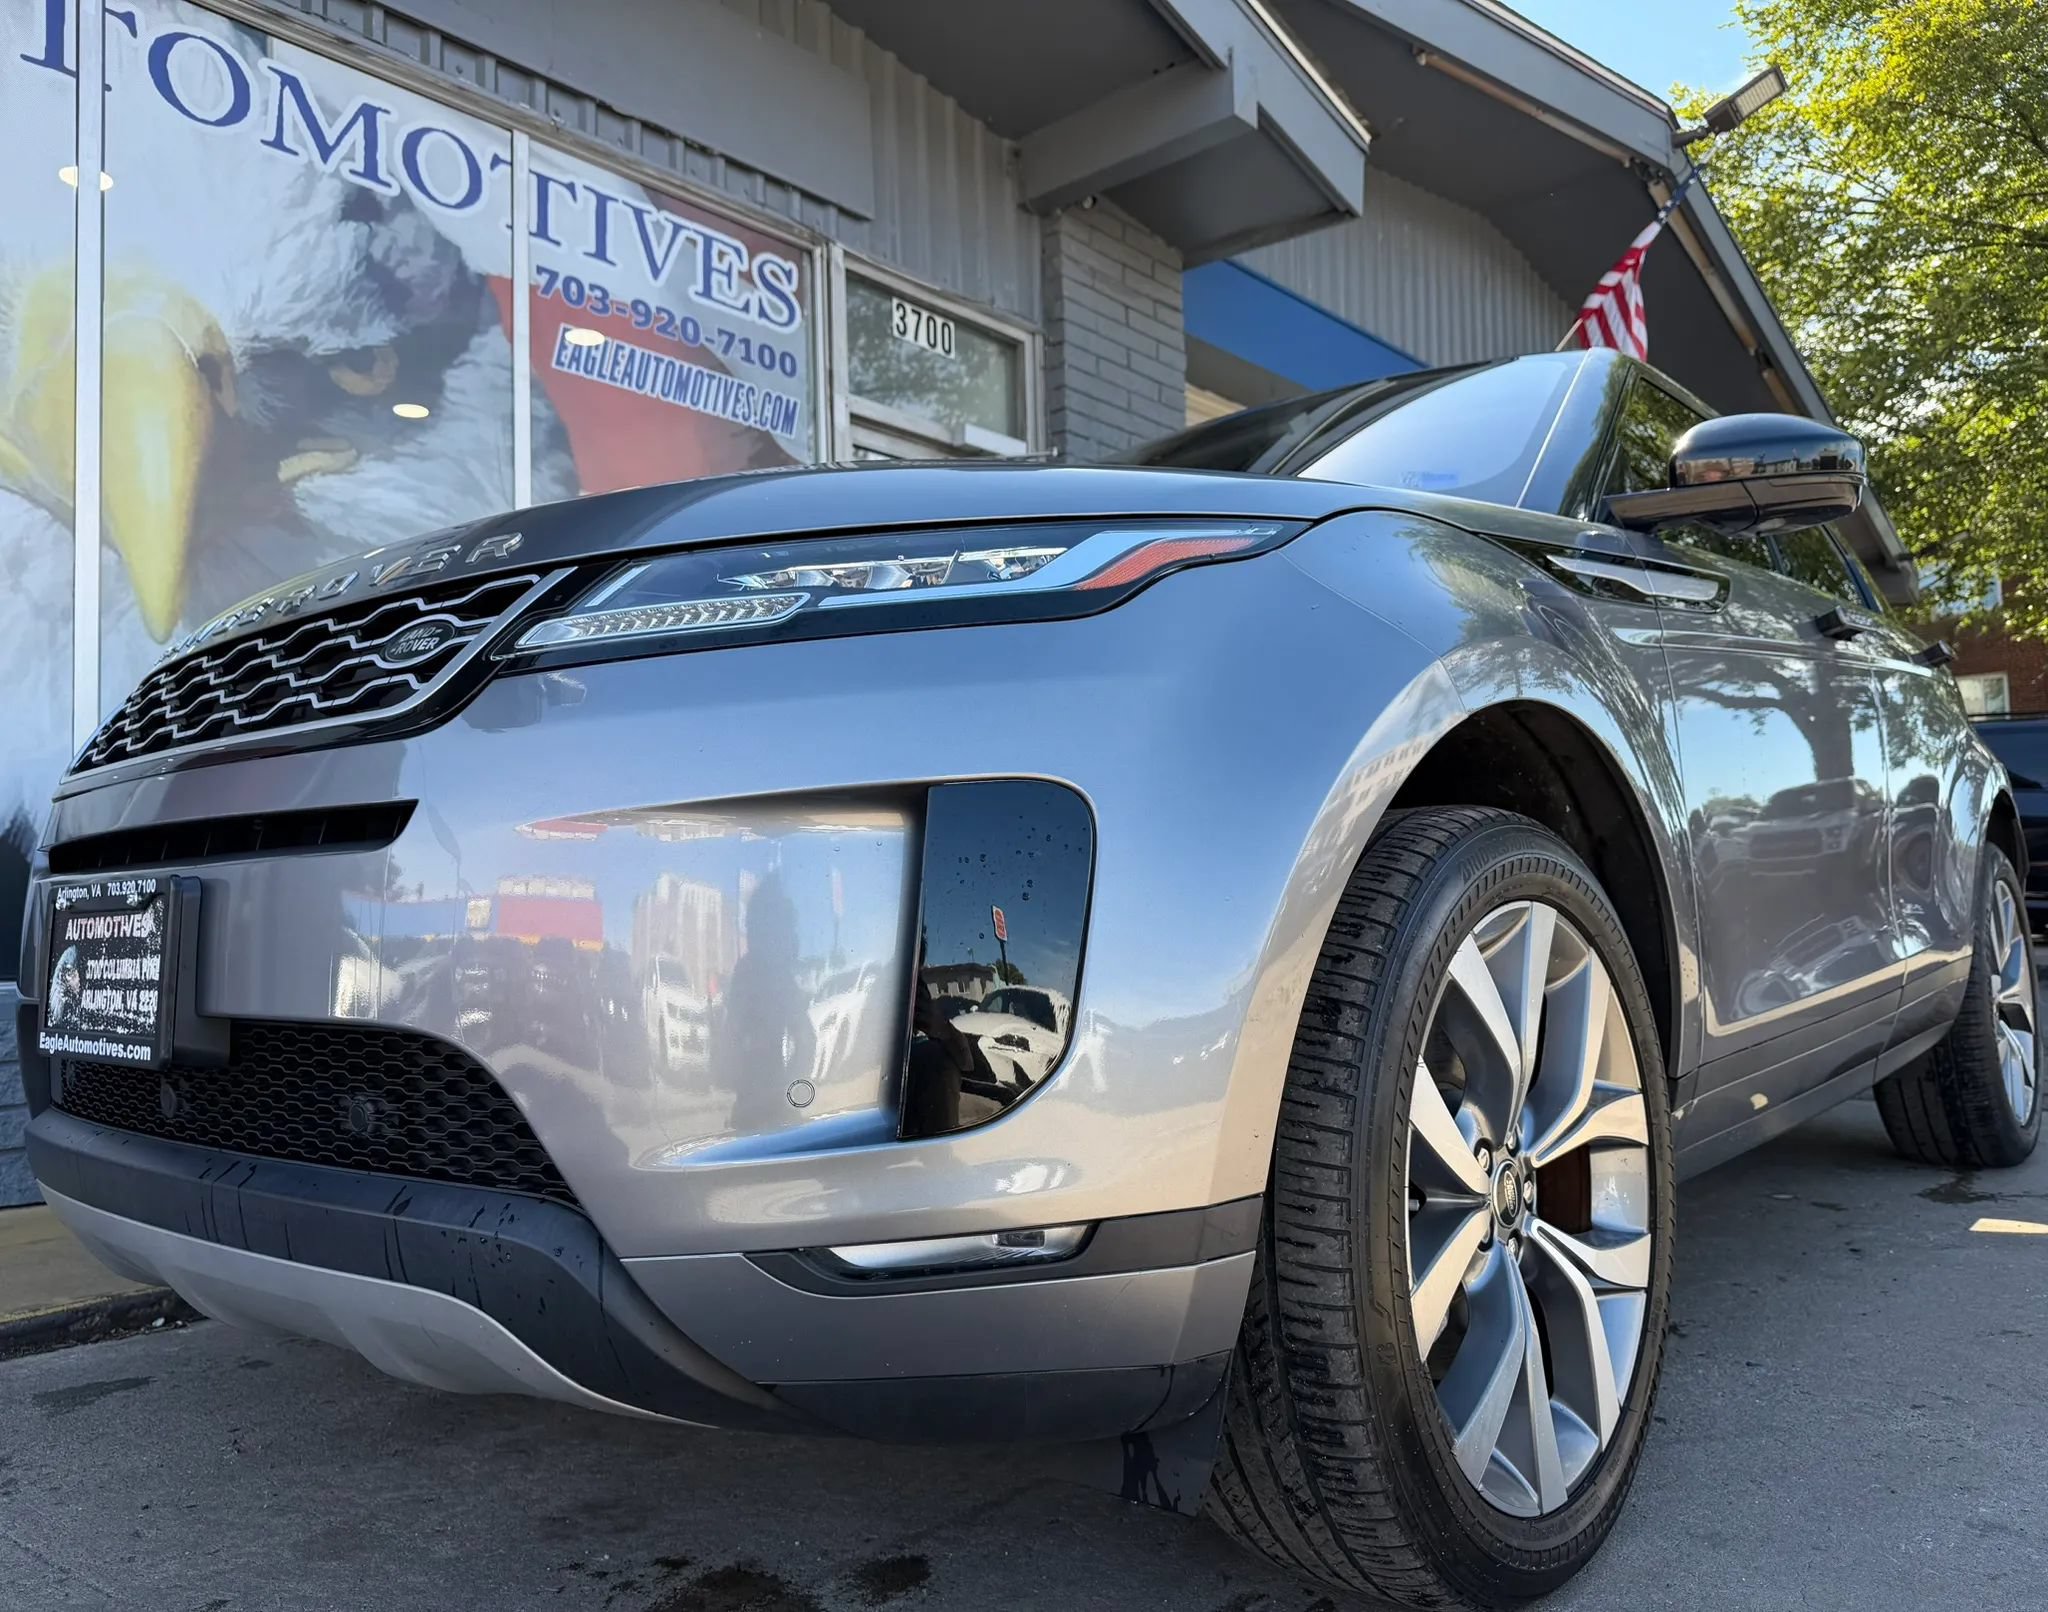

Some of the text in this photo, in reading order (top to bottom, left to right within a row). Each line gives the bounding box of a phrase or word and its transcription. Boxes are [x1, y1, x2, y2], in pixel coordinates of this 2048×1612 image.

[535, 265, 798, 378] 703-920-7100
[895, 302, 953, 355] 3700
[555, 326, 799, 435] EAGLEAUTOMOTIVES.COM
[394, 637, 441, 656] ROVER
[400, 626, 437, 643] LAND
[91, 884, 102, 897] VA
[107, 879, 156, 896] 703.920.7100
[65, 912, 152, 941] AUTOMOTIVES
[39, 1031, 151, 1061] EagleAutomotives.com
